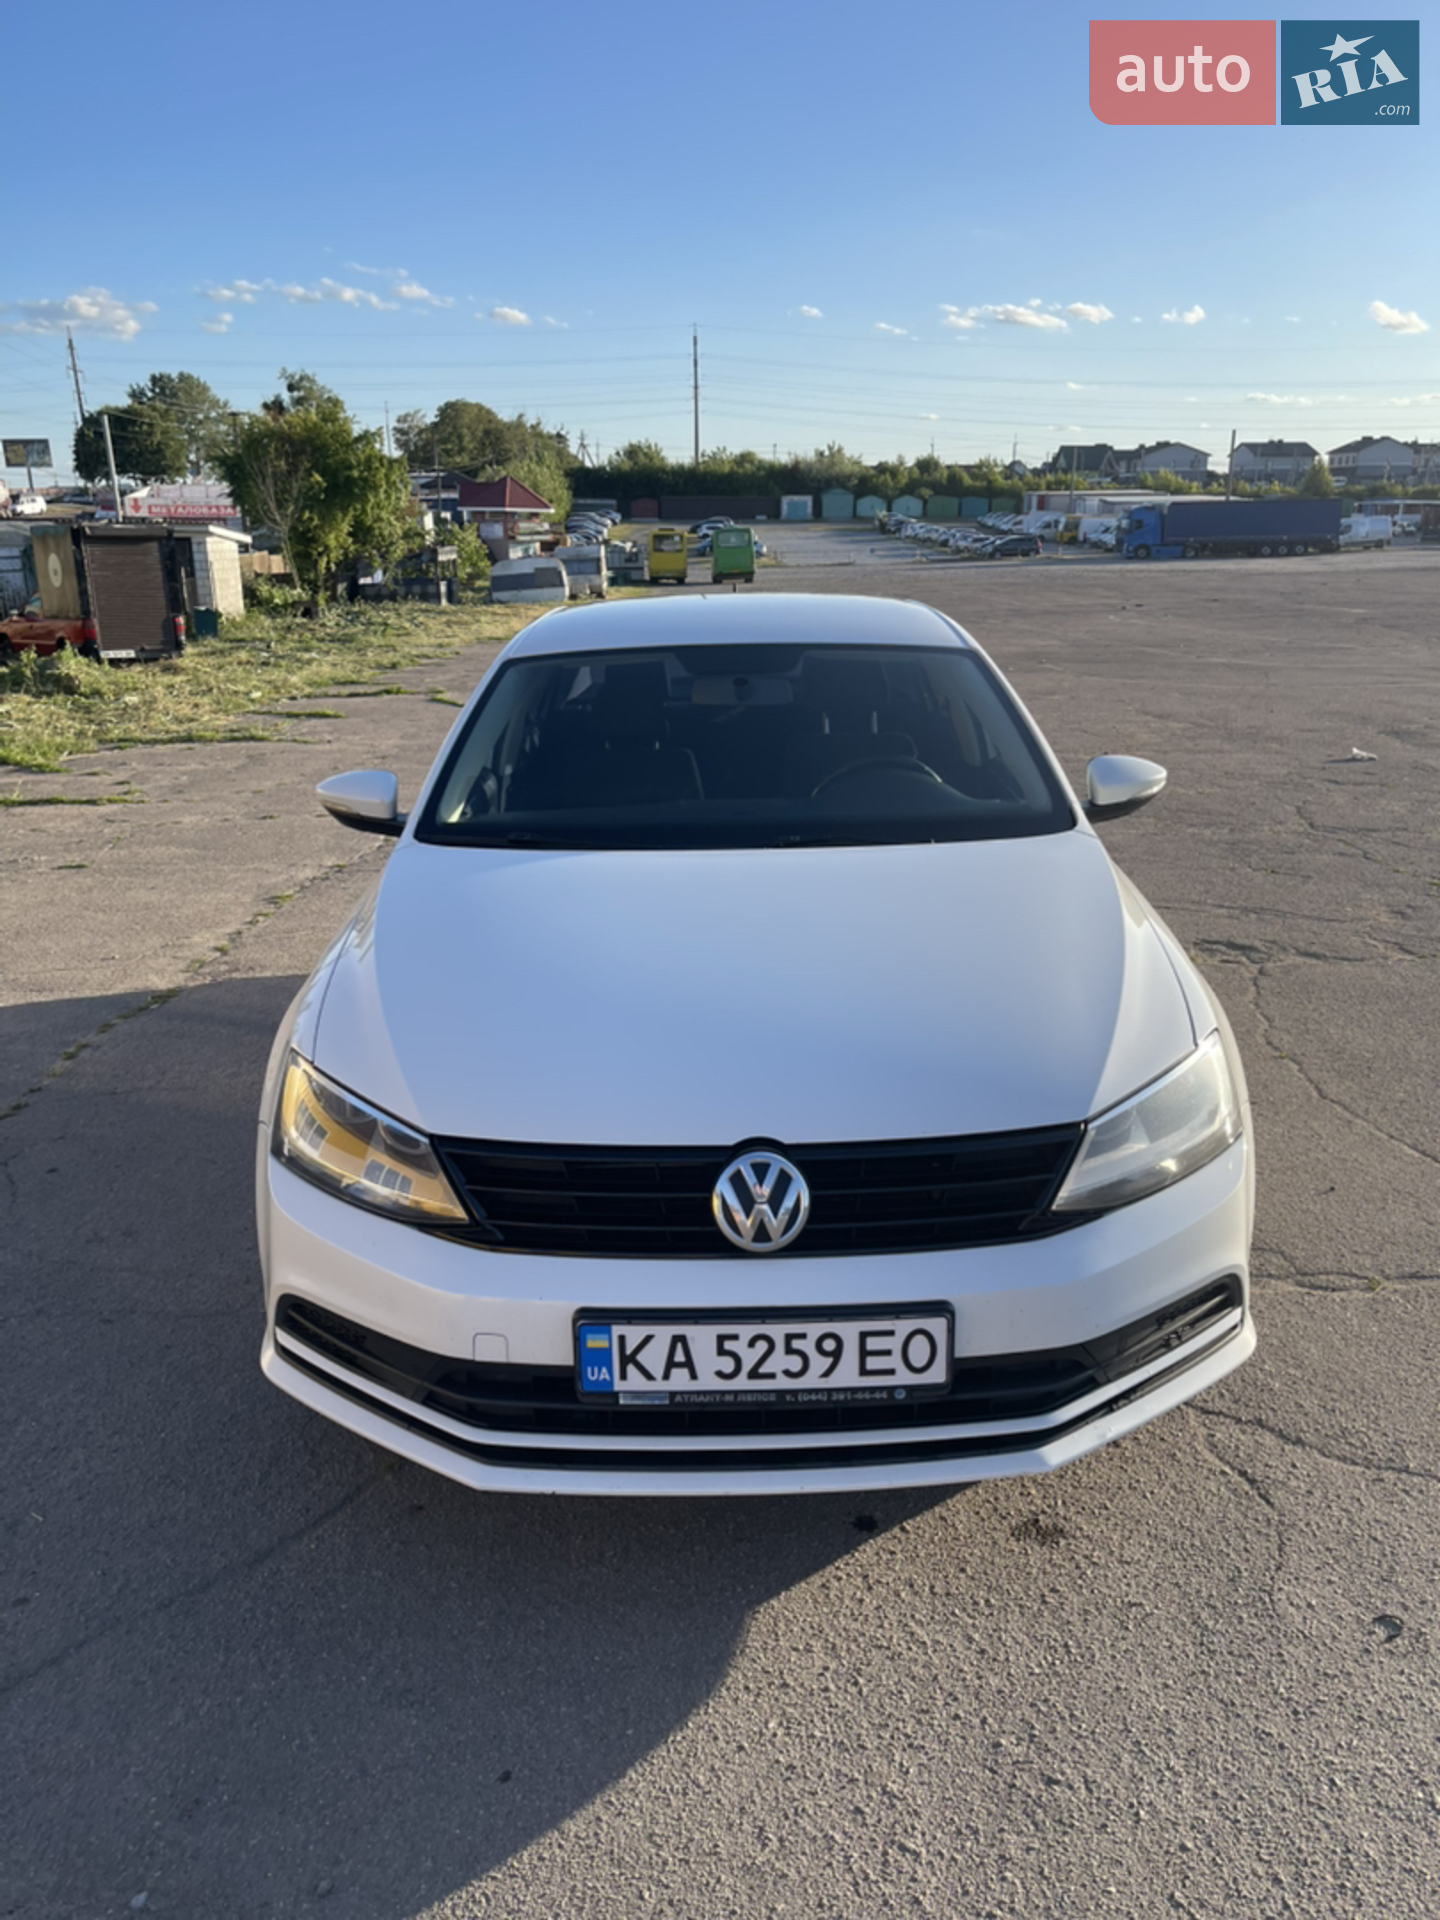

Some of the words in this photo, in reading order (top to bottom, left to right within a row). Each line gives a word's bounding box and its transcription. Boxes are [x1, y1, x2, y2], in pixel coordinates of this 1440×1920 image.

[617, 1333, 699, 1382] KA
[714, 1331, 845, 1381] 5259
[858, 1327, 938, 1378] EO
[587, 1366, 611, 1381] UA
